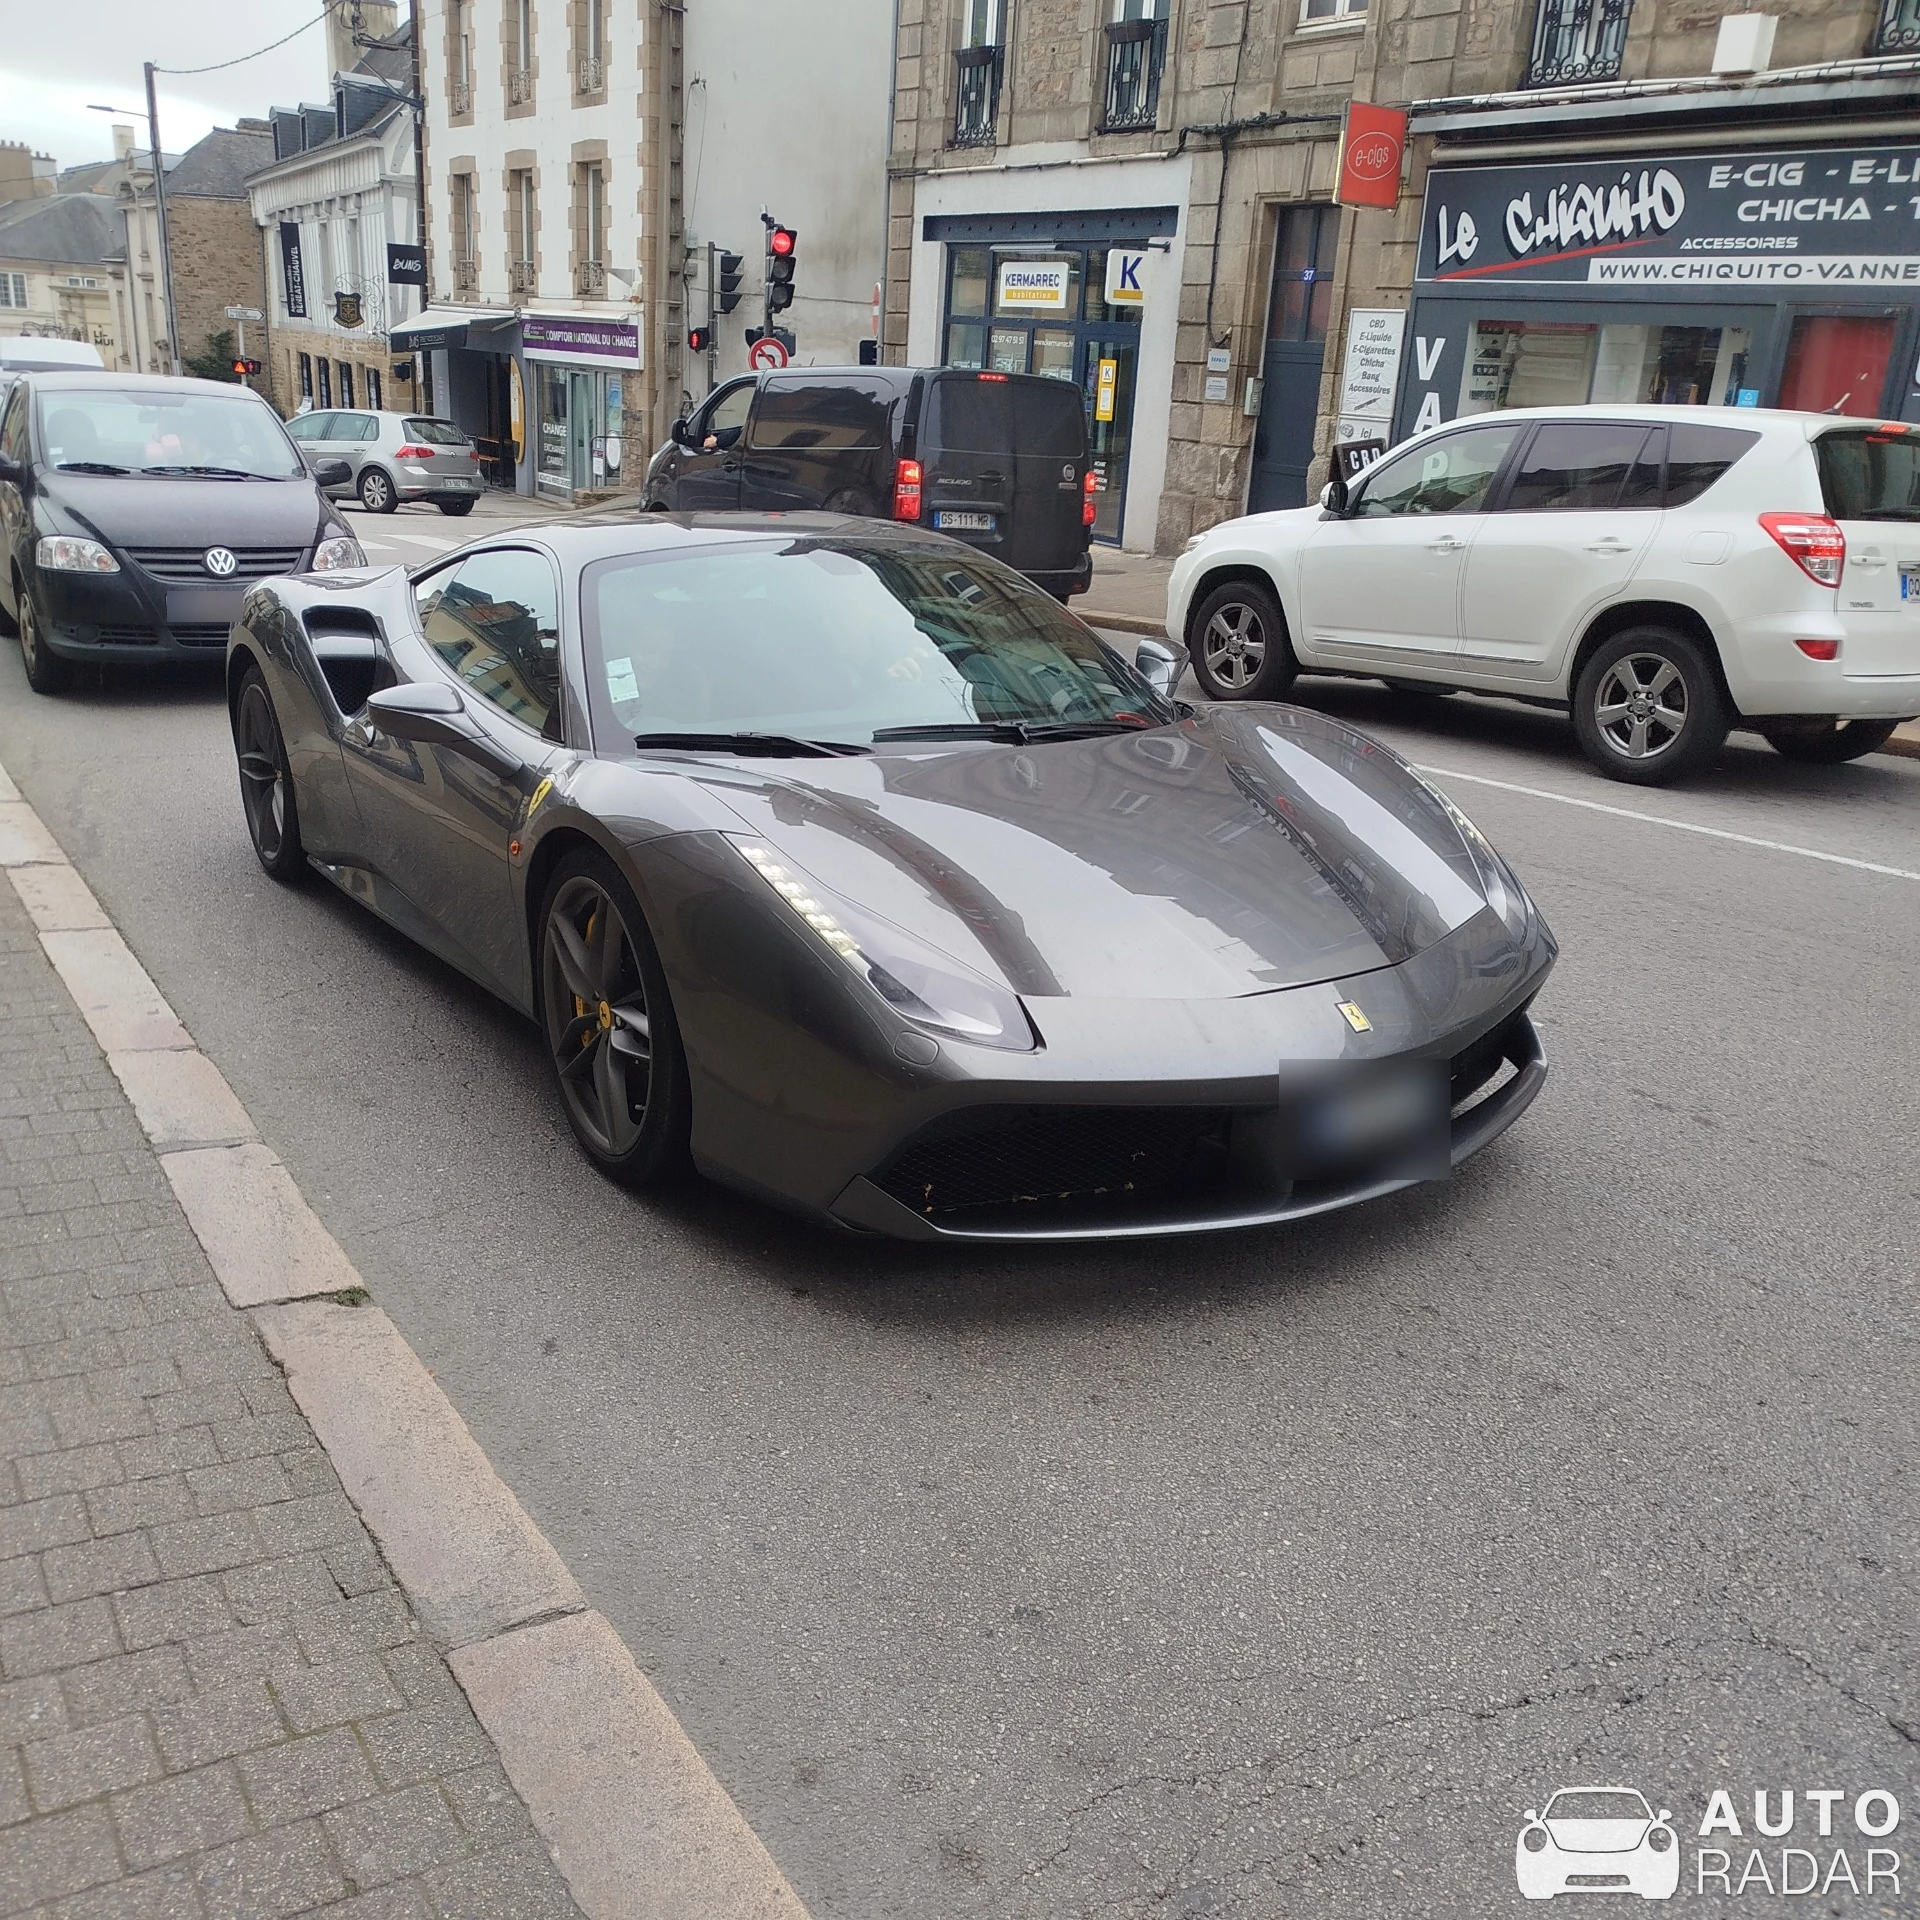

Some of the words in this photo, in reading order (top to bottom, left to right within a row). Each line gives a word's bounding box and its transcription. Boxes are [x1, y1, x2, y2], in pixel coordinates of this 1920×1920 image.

[1355, 144, 1389, 168] e-cigs
[1708, 162, 1806, 189] E-CIG
[1737, 197, 1872, 222] CHICHA
[1437, 204, 1480, 266] Le
[1680, 236, 1799, 250] ACCESSOIRES
[393, 258, 422, 272] BUNS
[1120, 255, 1144, 290] K
[1303, 270, 1314, 281] 37
[1005, 273, 1060, 287] KERMARREC
[1012, 291, 1051, 299] habitation
[1369, 319, 1386, 329] CBD
[545, 330, 573, 343] COMPTOIR
[573, 332, 601, 345] NATIONAL
[602, 334, 611, 346] DU
[611, 335, 637, 348] CHANGE
[1359, 332, 1392, 343] E-Liquide
[1352, 344, 1396, 356] E-Cigarettes
[1360, 358, 1385, 368] Chicha
[1361, 371, 1381, 382] Bang
[1348, 383, 1391, 395] Accessoires
[543, 422, 567, 437] CHANGE
[543, 442, 566, 455] EXCHANGE
[941, 513, 989, 527] GS-111-MR
